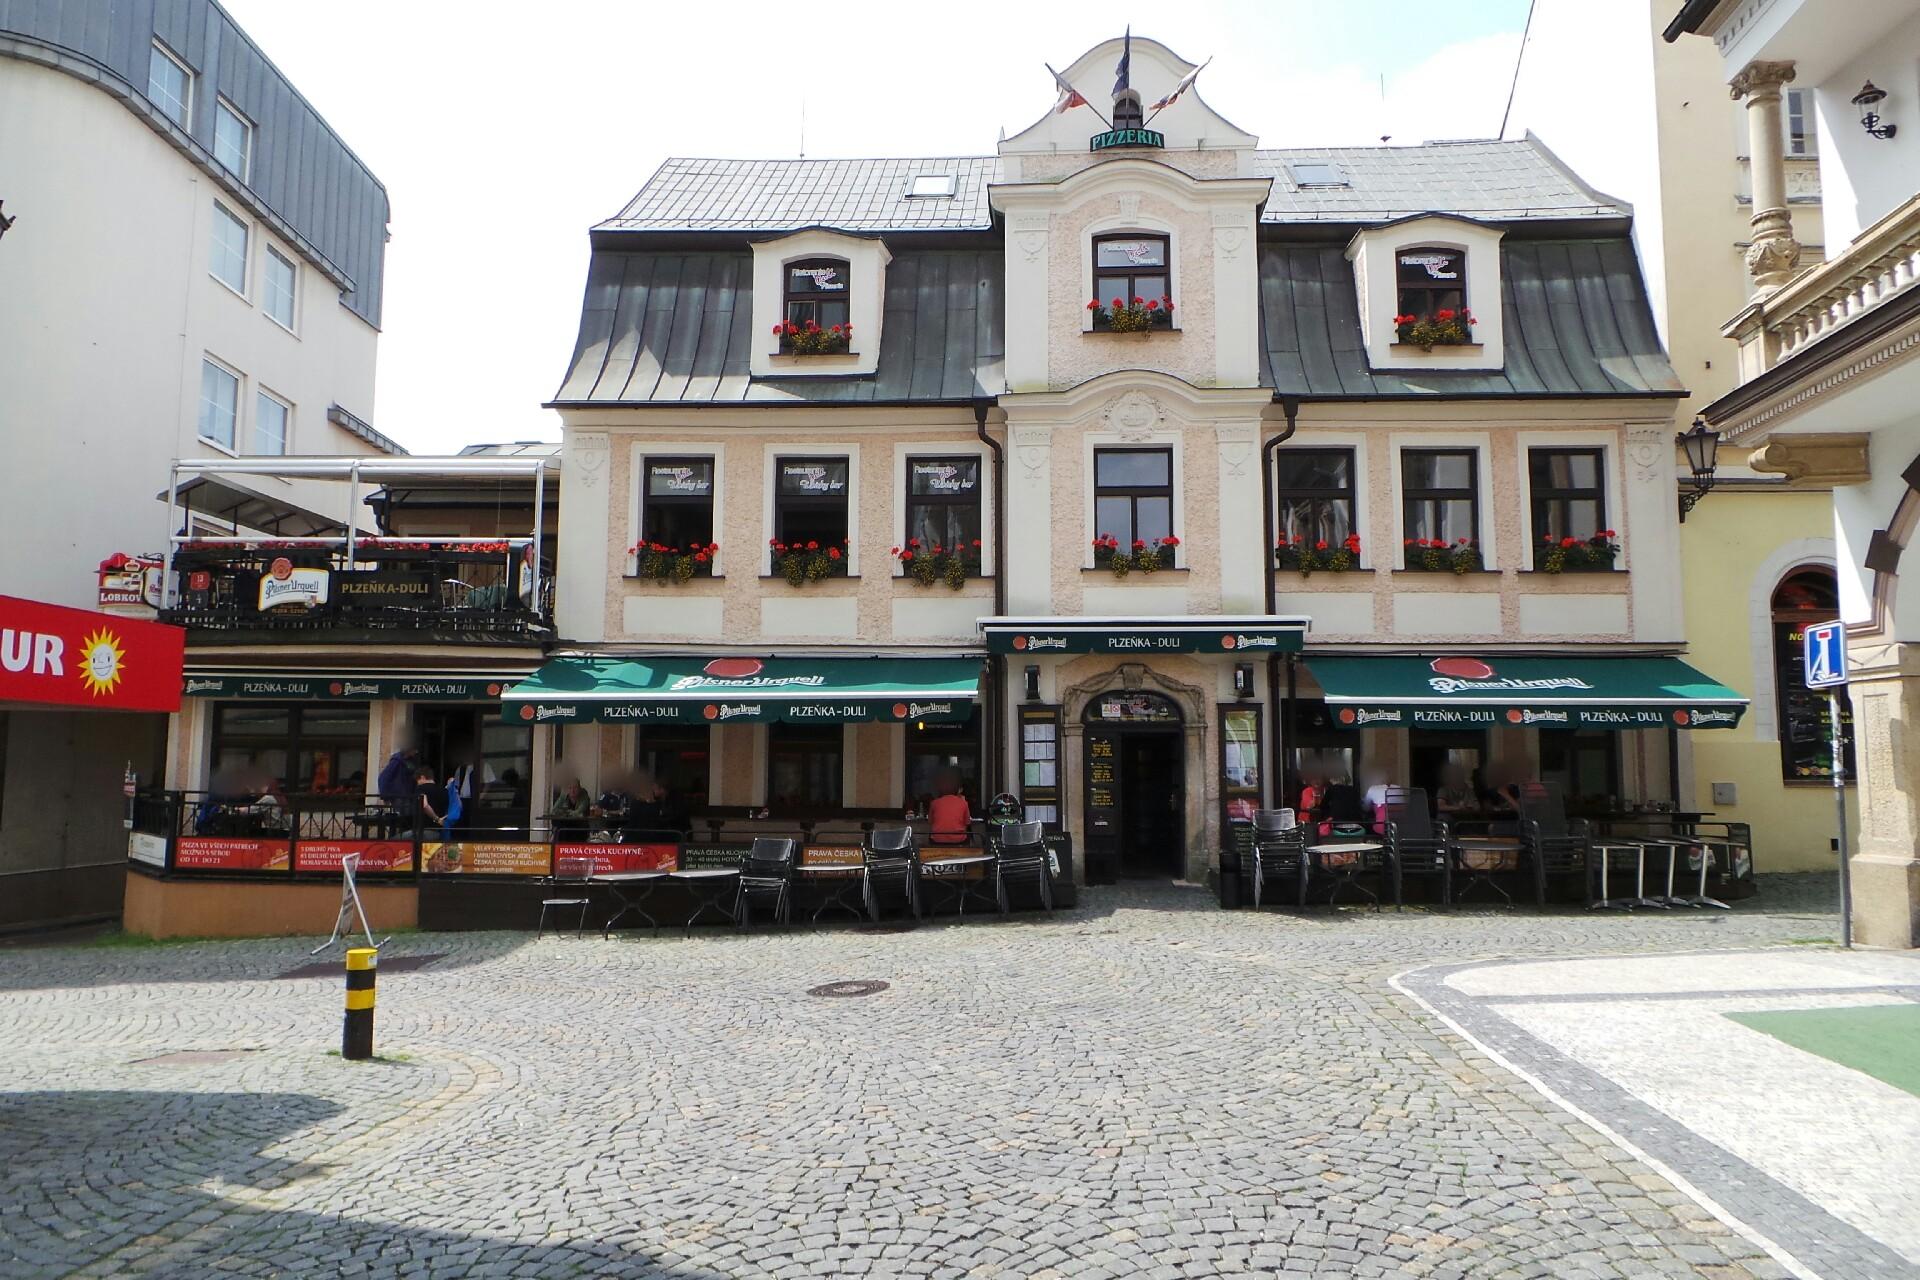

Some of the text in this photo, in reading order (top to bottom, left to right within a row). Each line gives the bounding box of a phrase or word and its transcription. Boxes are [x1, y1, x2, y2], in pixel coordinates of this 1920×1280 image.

[1092, 130, 1162, 149] PIZZERIA
[265, 580, 319, 599] Pilsner Urquell
[341, 580, 428, 594] PLZEŇKA-DULI
[1108, 636, 1151, 648] PLZEŇKA
[1158, 638, 1180, 648] DULI
[244, 682, 281, 693] PLZEŇKA
[288, 683, 309, 693] DULI
[402, 683, 440, 694] PLZEŇKA
[447, 685, 466, 694] DULI
[670, 675, 825, 690] Pilsner Urquell
[1428, 677, 1585, 693] Pilsner Urquell
[604, 704, 648, 717] PLZEŇKA
[656, 707, 679, 717] DULI
[790, 704, 835, 717] PLZEŇKA
[844, 706, 867, 717] DULI
[1415, 709, 1462, 722] PLZEŇKA
[1470, 712, 1495, 722] DULI
[1581, 709, 1628, 722] PLZEŇKA
[1638, 712, 1664, 722] DULI
[584, 847, 606, 855] ČESKÁ
